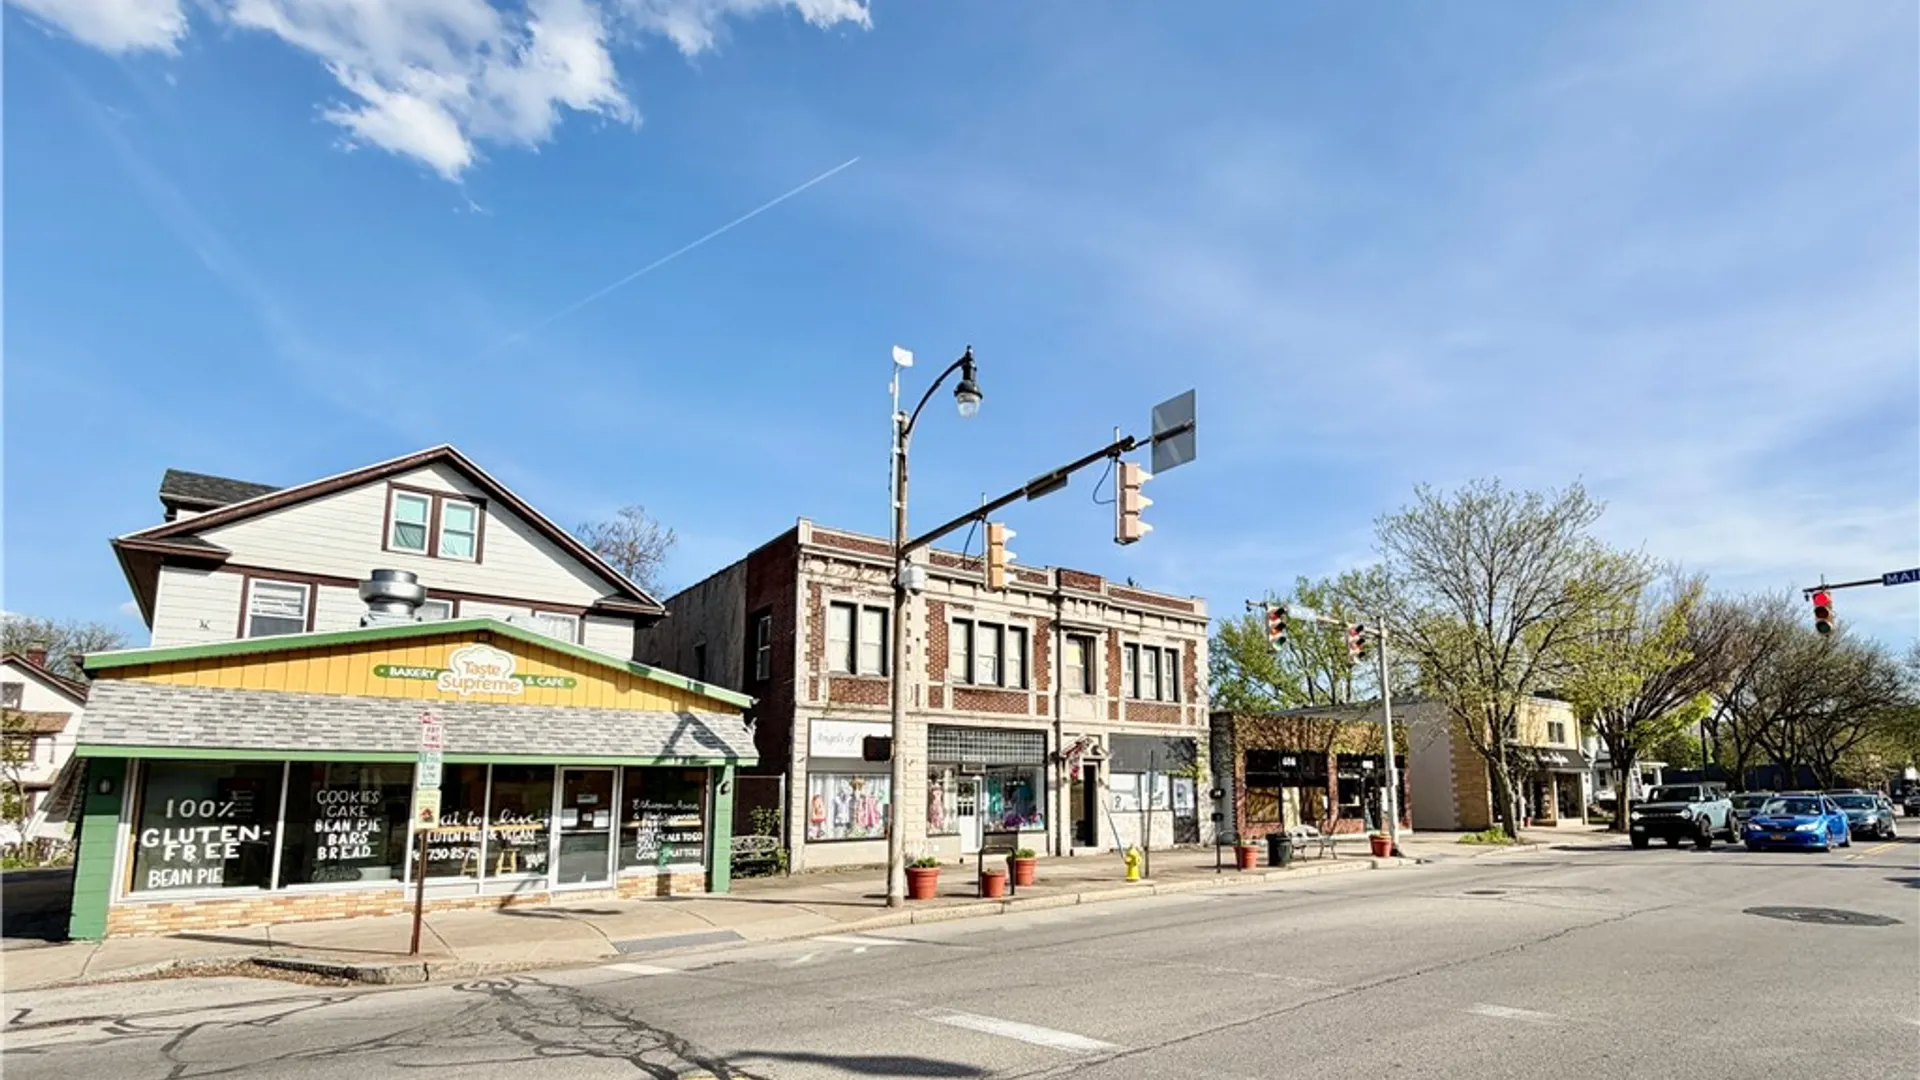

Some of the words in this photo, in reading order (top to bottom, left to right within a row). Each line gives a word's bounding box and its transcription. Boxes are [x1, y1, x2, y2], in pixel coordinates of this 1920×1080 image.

[1886, 570, 1920, 584] MAI
[389, 667, 437, 679] BAKERY
[462, 660, 501, 675] Taste
[440, 674, 520, 693] Supreme
[525, 677, 534, 685] &
[316, 789, 380, 805] COOKIES
[166, 799, 236, 818] 100%
[326, 805, 369, 818] CAKE
[314, 819, 351, 833] BEAN
[356, 818, 382, 833] PIE
[140, 825, 272, 847] GLUTEN-
[327, 831, 370, 846] BARS
[163, 842, 241, 861] FREE
[317, 844, 373, 861] BREAD
[147, 868, 193, 889] BEAN
[196, 866, 225, 885] PIE
